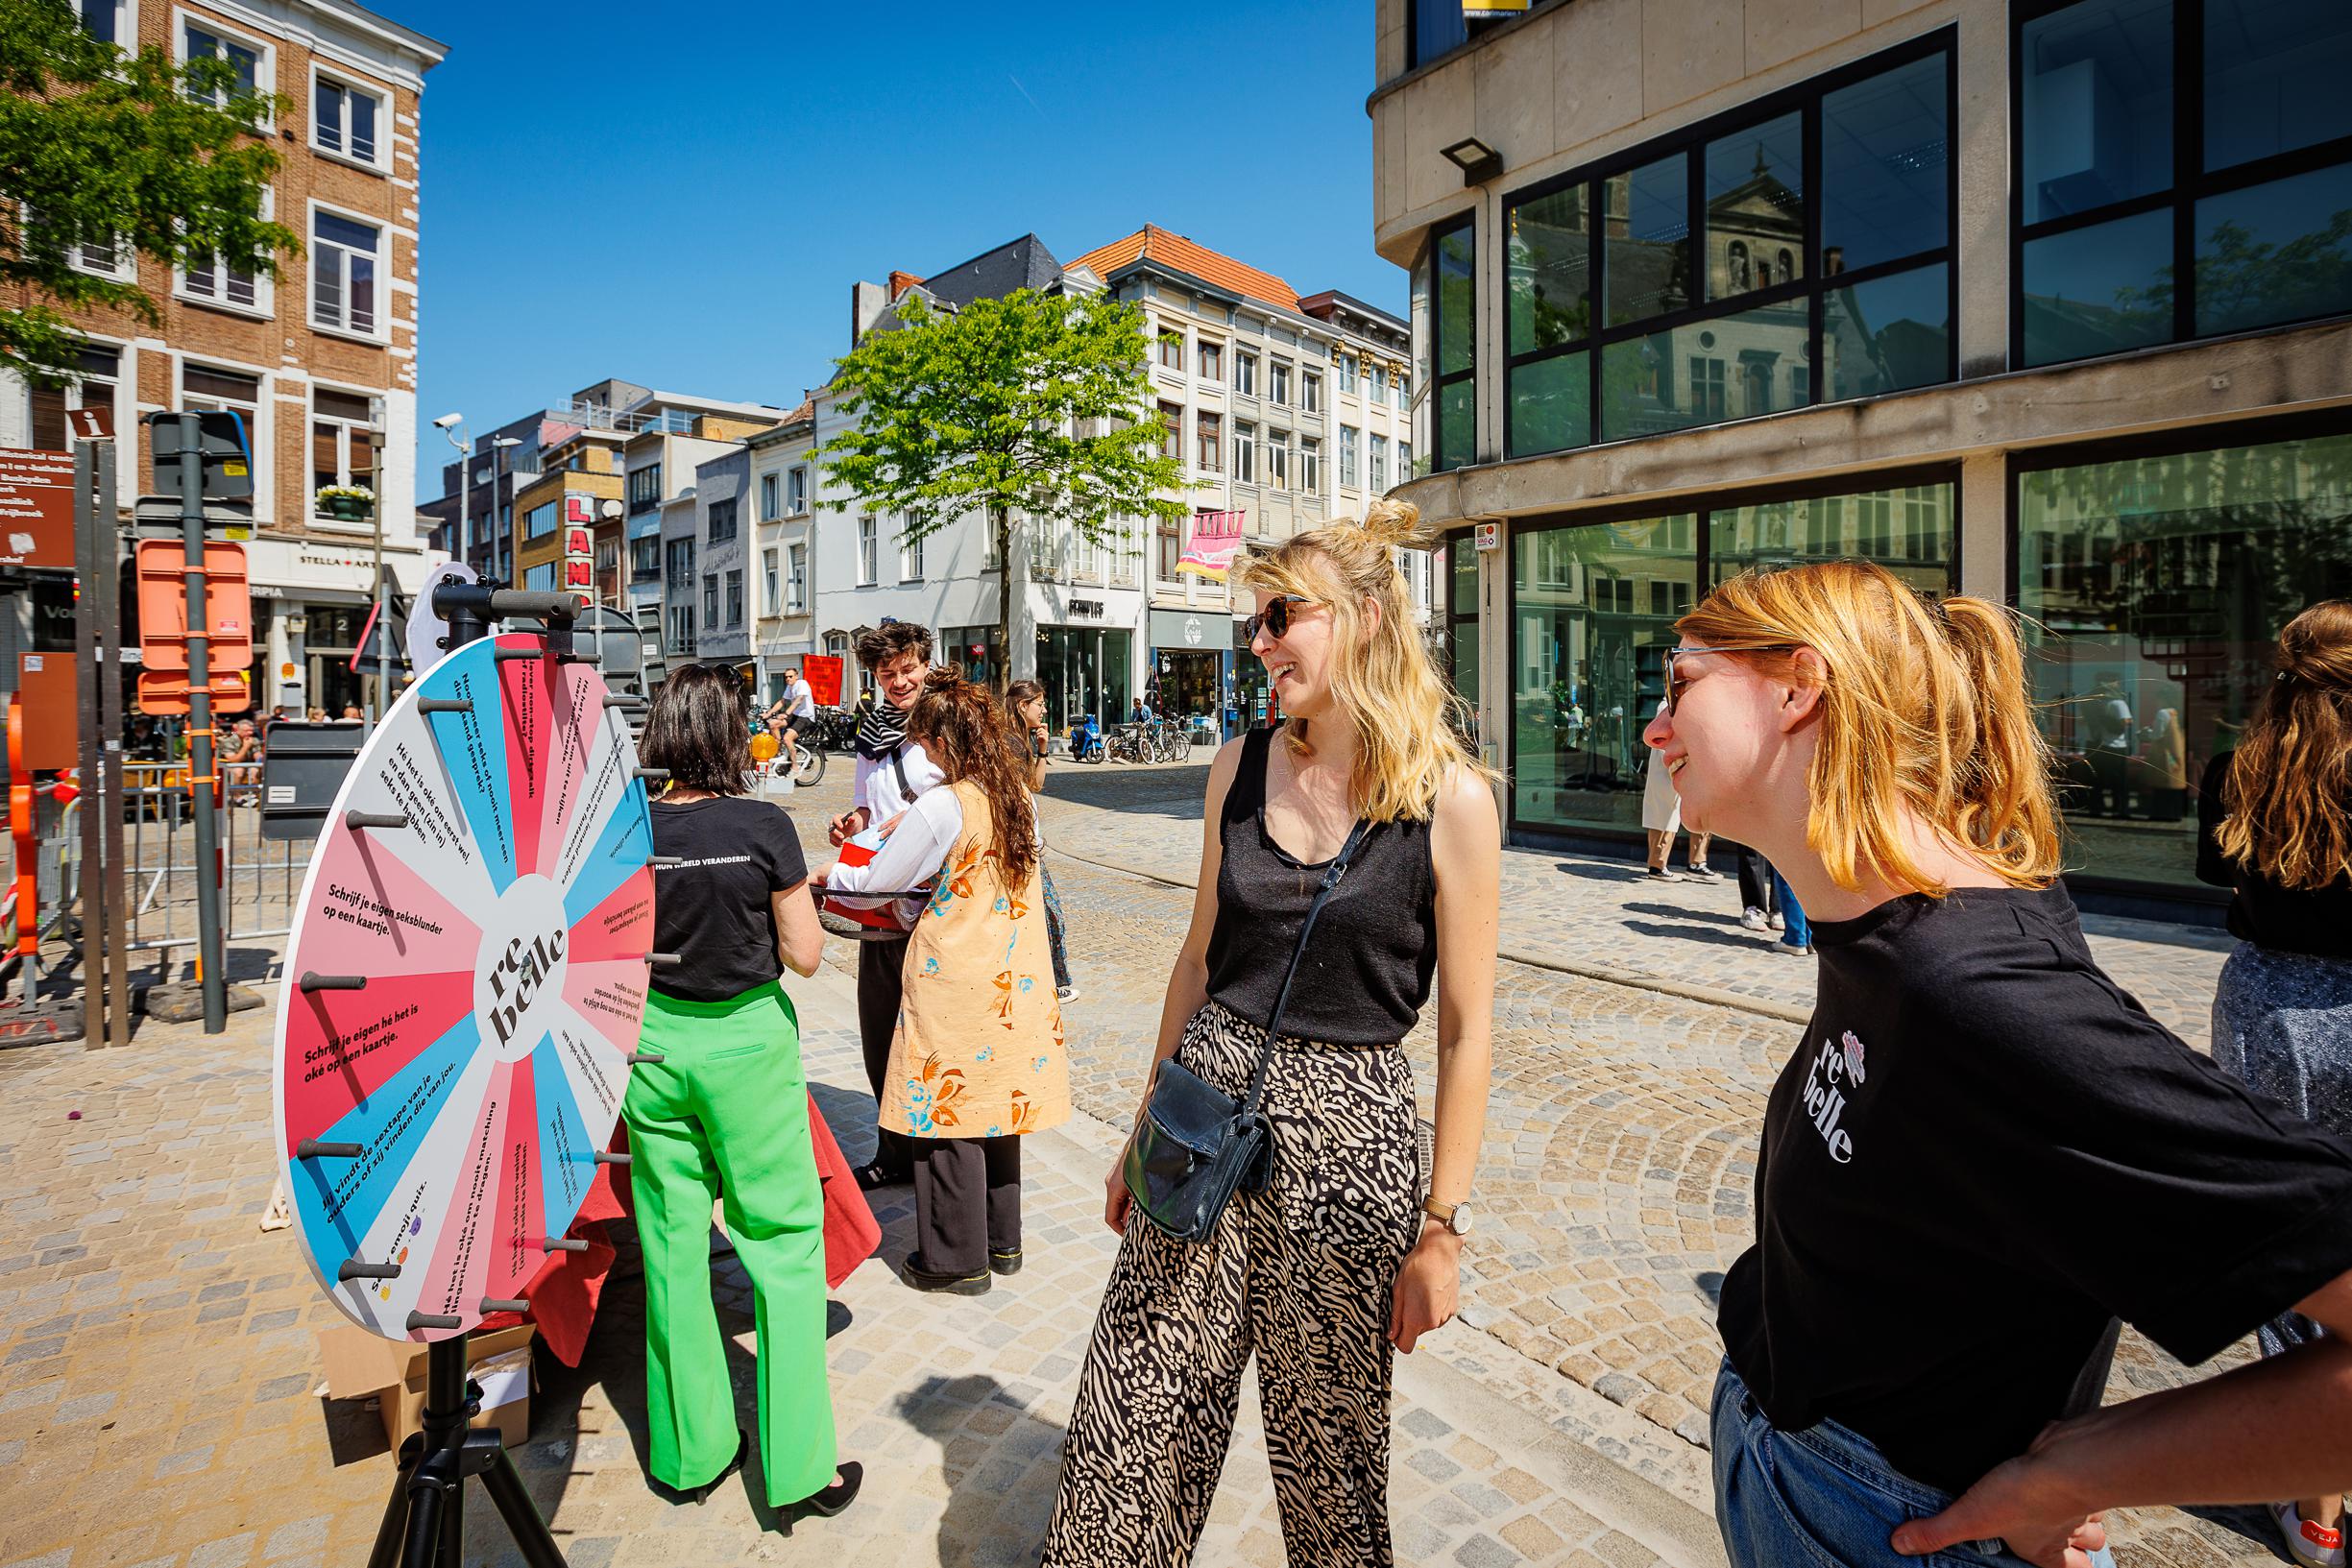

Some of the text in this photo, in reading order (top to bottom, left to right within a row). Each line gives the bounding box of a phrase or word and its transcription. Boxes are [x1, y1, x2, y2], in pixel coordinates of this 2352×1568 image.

[301, 556, 340, 566] STELLA
[568, 498, 591, 606] LAM
[337, 619, 349, 631] 2
[453, 680, 484, 792] dieaand gesprek?
[477, 741, 486, 767] seks
[379, 770, 425, 843] seks te hebben.
[388, 758, 446, 848] en dan geen (zin in)
[396, 742, 470, 864] Hé het is oké om eerst wel,
[484, 769, 492, 781] of
[487, 783, 497, 812] nooit
[494, 813, 503, 840] meer
[702, 856, 751, 865] VERANDEREN
[323, 905, 389, 935] op een kaartje.
[328, 883, 442, 934] Schrijf je eigen seksblunder
[488, 929, 566, 1049] belle
[489, 938, 523, 1003] re
[303, 1031, 398, 1082] oké op een kaartje.
[304, 1003, 418, 1064] Schrijf je eigen hé het is
[1820, 1038, 1844, 1084] re
[1804, 1056, 1852, 1164] belle
[322, 1074, 430, 1211] Jij vindt de sextape van je
[327, 1062, 455, 1223] ouders of zij vinden die van jou.
[390, 1214, 410, 1254] emoji
[410, 1181, 426, 1212] quiz.
[443, 1101, 496, 1315] Hé het is oké om nooit matching
[450, 1152, 491, 1313] lingeriesetjes te dragen.
[2311, 1530, 2339, 1543] VEJA
